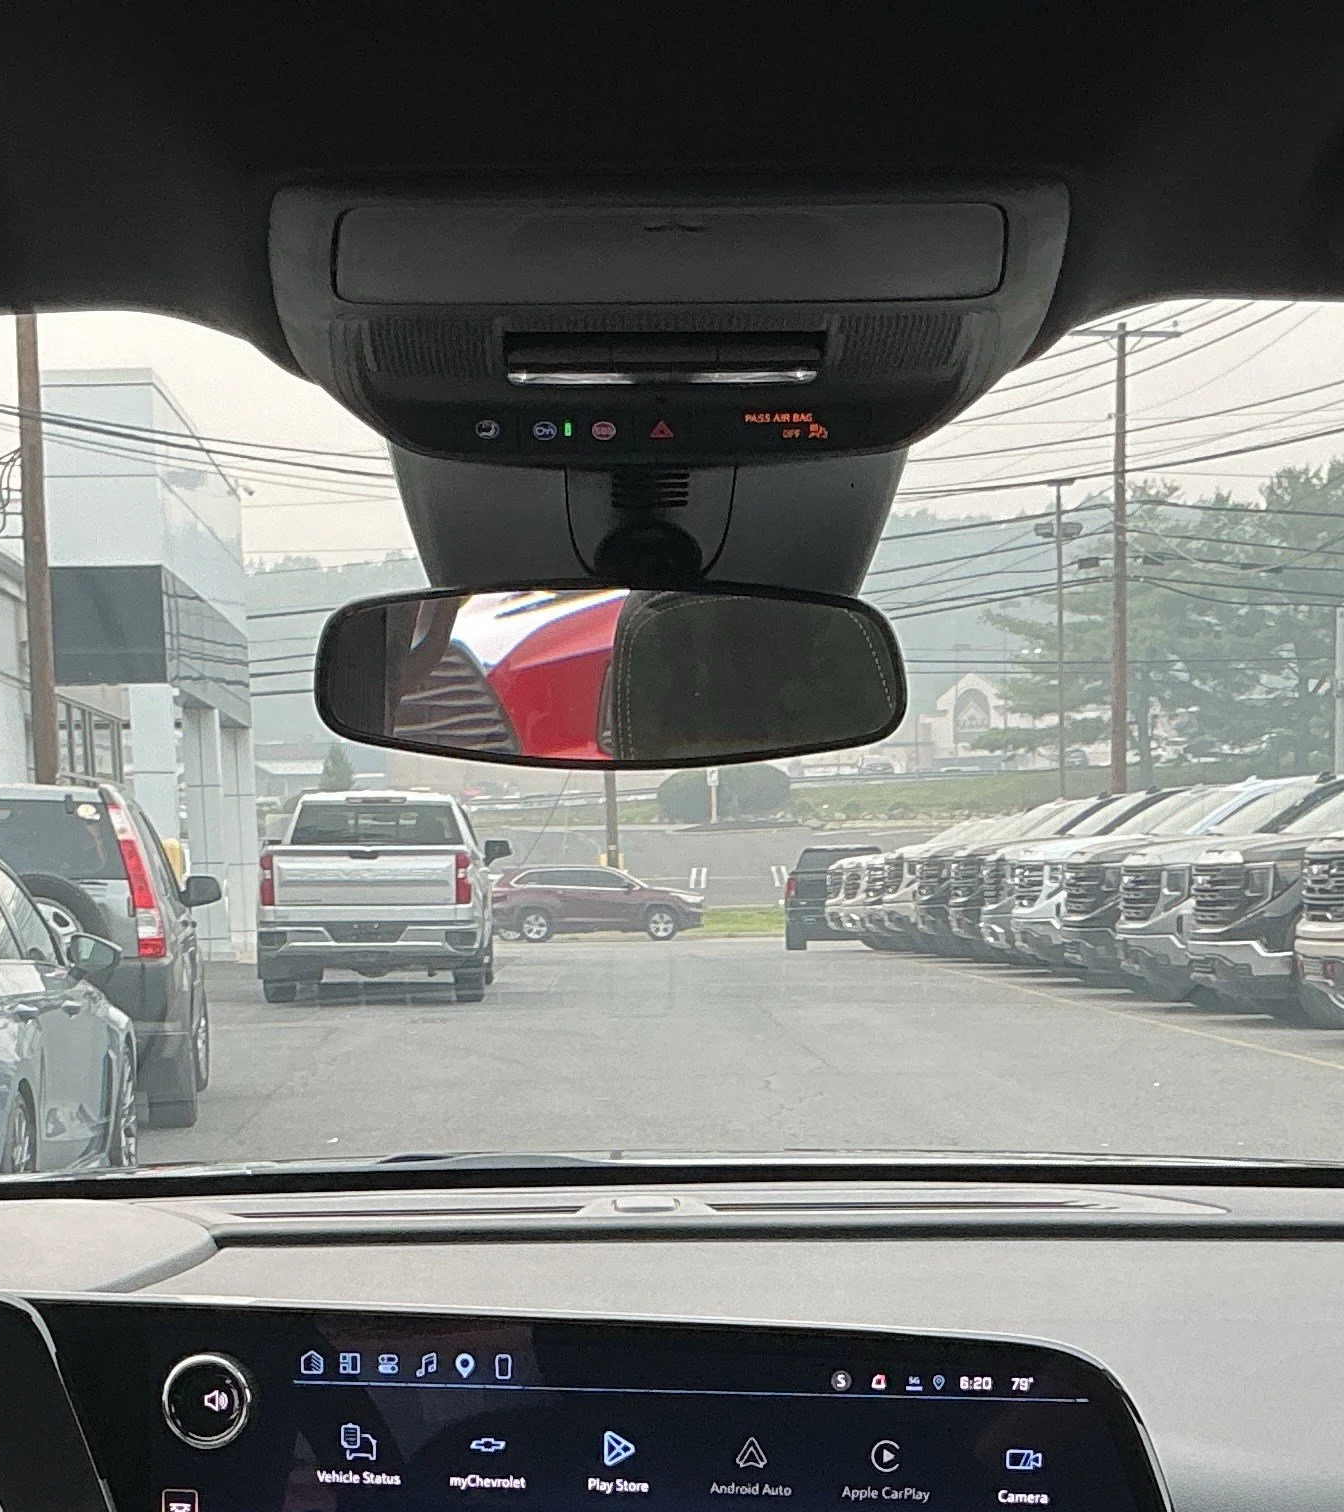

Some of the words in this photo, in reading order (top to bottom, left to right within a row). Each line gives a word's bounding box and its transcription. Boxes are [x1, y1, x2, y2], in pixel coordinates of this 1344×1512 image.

[744, 413, 771, 423] PASS
[959, 1376, 993, 1390] 6:20
[316, 1469, 360, 1485] Vehicle
[362, 1472, 402, 1487] Status
[449, 1474, 526, 1491] myChevrolet
[587, 1478, 614, 1496] Play
[615, 1479, 649, 1494] Store
[709, 1482, 759, 1497] Android
[761, 1483, 793, 1498] Auto
[841, 1486, 878, 1502] Apple
[881, 1487, 931, 1504] CarPlay
[997, 1490, 1049, 1505] Camera
